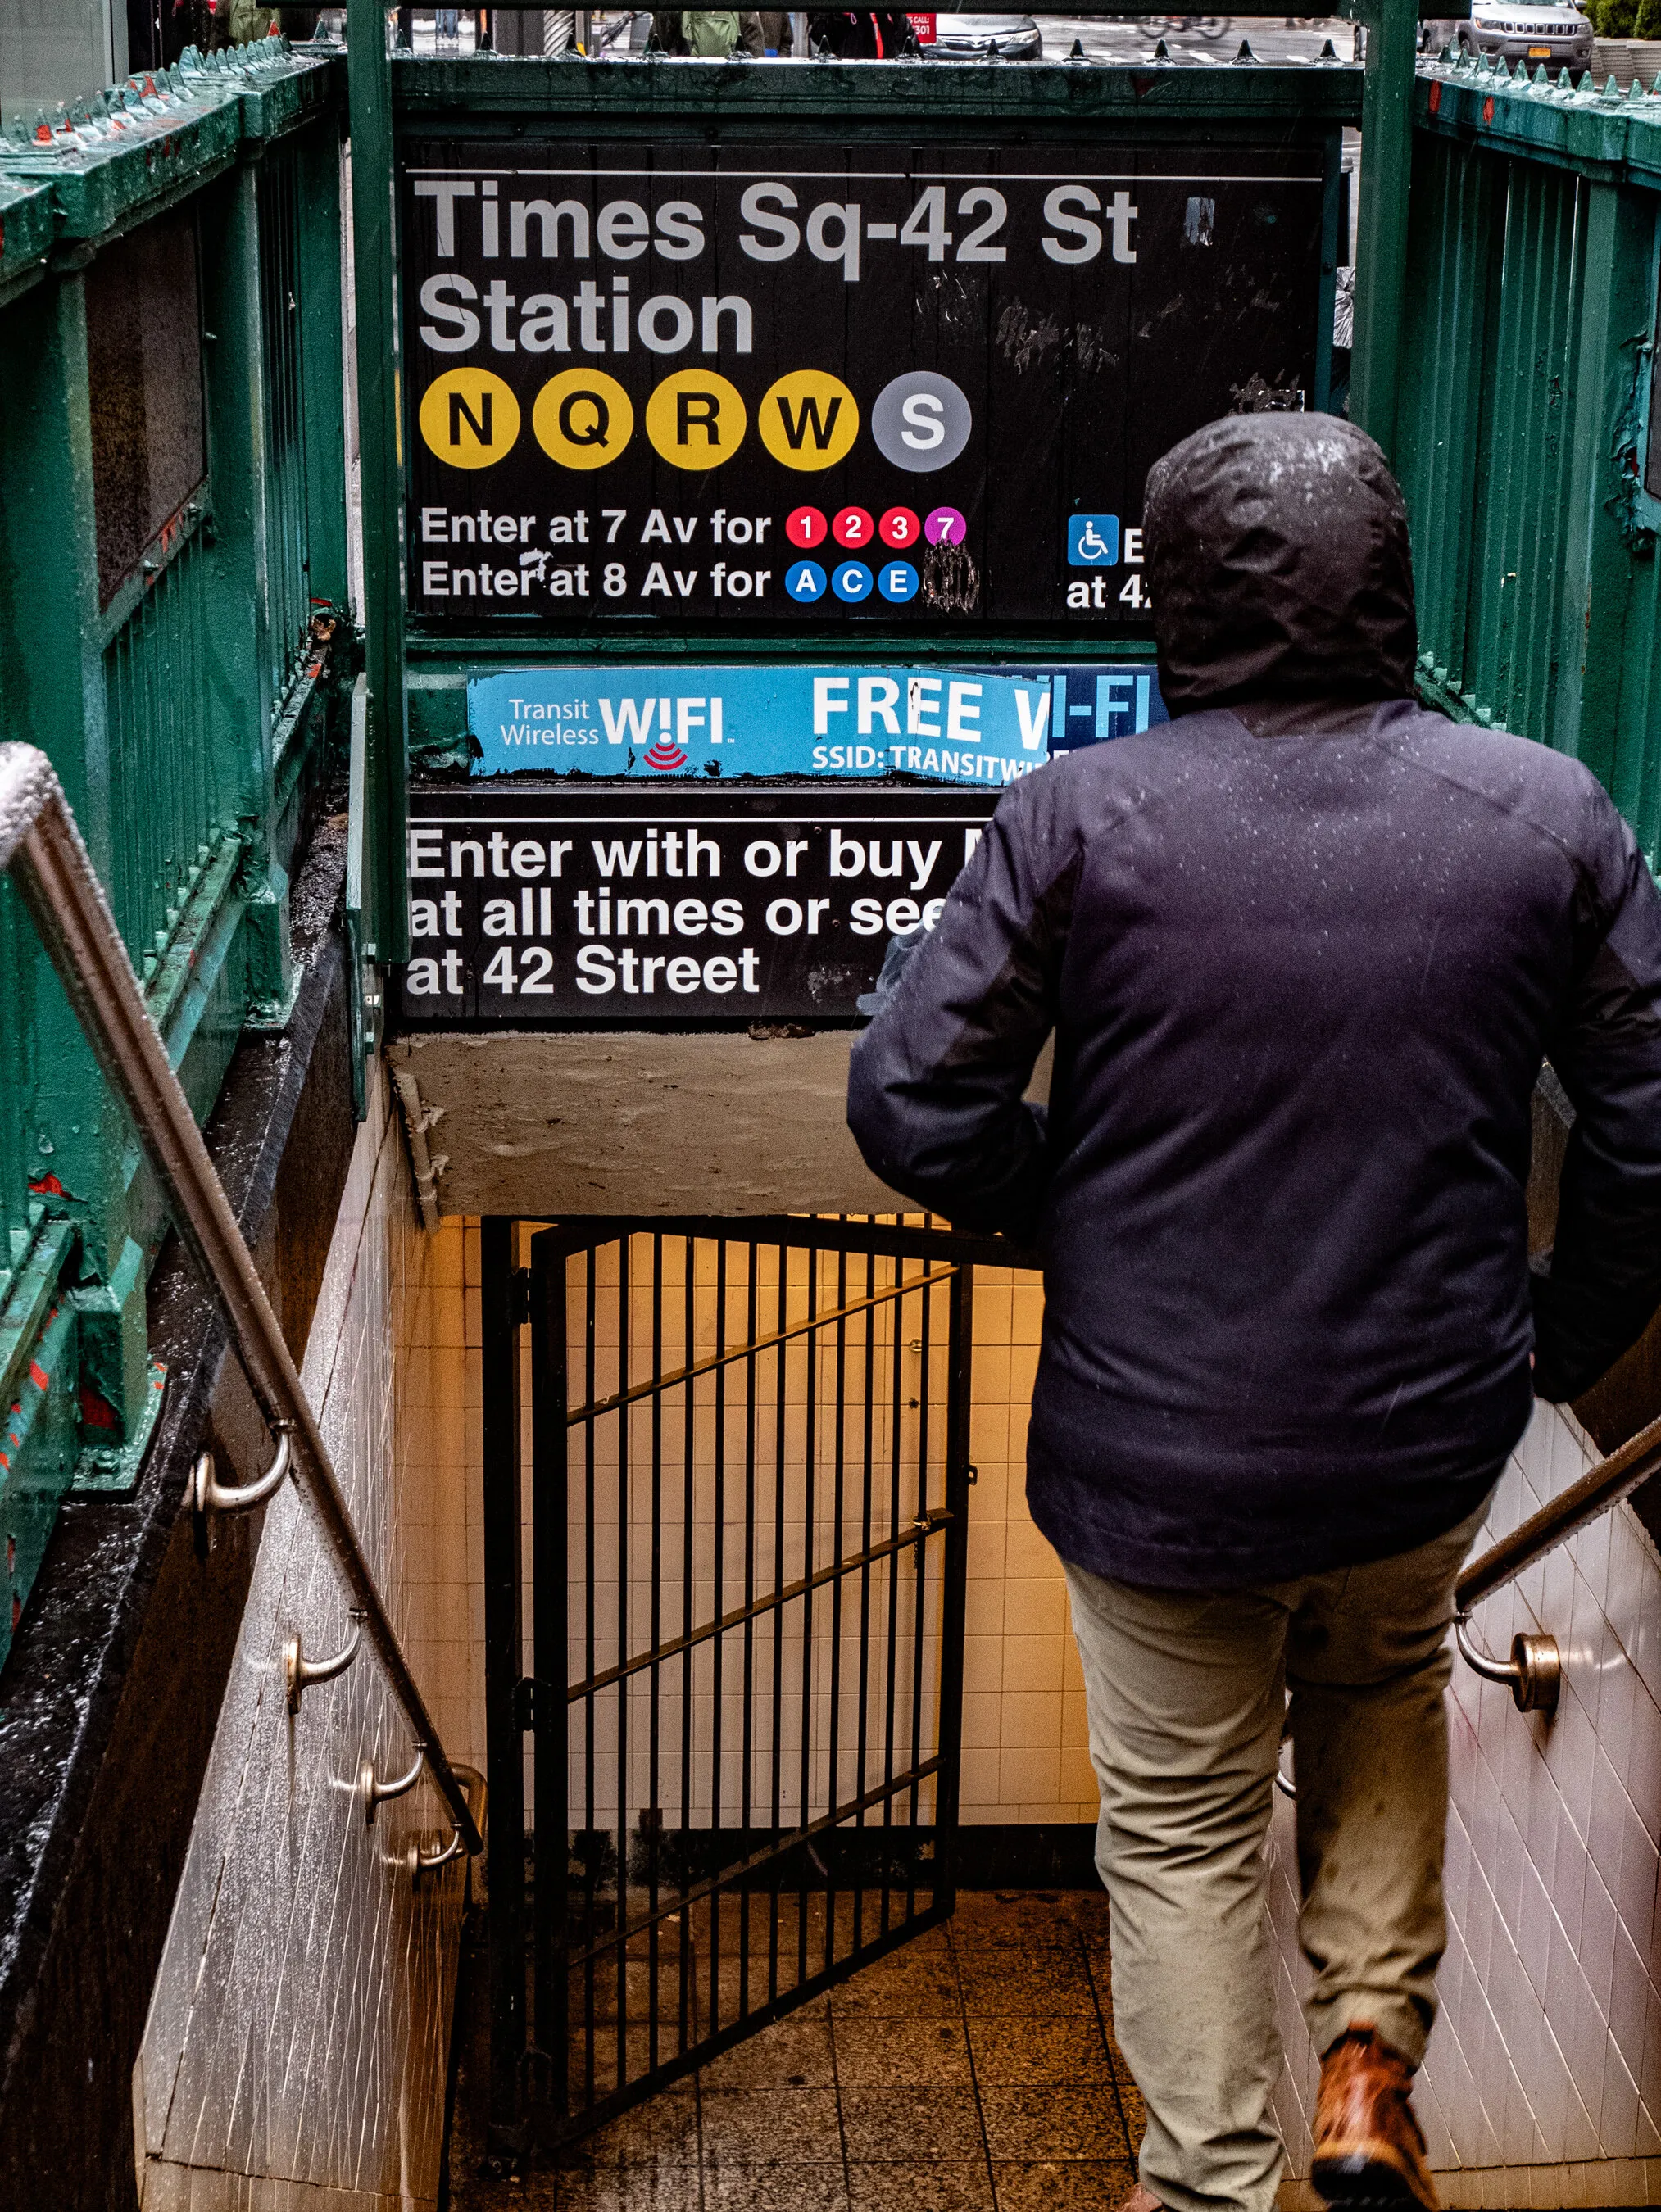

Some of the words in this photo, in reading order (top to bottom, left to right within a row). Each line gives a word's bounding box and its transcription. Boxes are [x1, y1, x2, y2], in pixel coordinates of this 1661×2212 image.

[414, 180, 706, 261] Times
[739, 181, 1008, 282] Sq-42
[1042, 184, 1138, 264] St
[419, 274, 752, 354] Station
[448, 392, 493, 446] N
[558, 390, 610, 448] Q
[677, 392, 721, 446] R
[776, 397, 842, 450] W
[901, 393, 946, 451] S
[421, 507, 536, 544] Enter
[549, 510, 590, 543] at
[601, 509, 627, 543] 7
[640, 509, 698, 543] Av
[710, 508, 772, 544] for
[800, 515, 811, 539] 1
[845, 514, 862, 538] 2
[892, 515, 908, 540] 3
[937, 517, 955, 539] 7
[421, 561, 533, 596] Enter
[549, 564, 590, 597] at
[603, 562, 627, 597] 8
[640, 562, 698, 597] Av
[710, 562, 772, 597] for
[795, 569, 817, 592] A
[842, 569, 863, 593] C
[890, 569, 908, 593] E
[1066, 575, 1107, 609] at
[508, 699, 590, 721] Transit
[813, 676, 983, 739] FREE
[501, 723, 599, 746] Wireless
[812, 746, 885, 768] SSID:
[406, 829, 573, 878] Enter
[592, 828, 721, 877] with
[743, 840, 809, 877] or
[829, 828, 942, 891] buy
[409, 890, 463, 937] at
[483, 887, 552, 936] all
[573, 886, 745, 936] times
[765, 898, 830, 936] or
[407, 949, 464, 995] at
[483, 946, 554, 994] 42
[575, 944, 760, 995] Street
